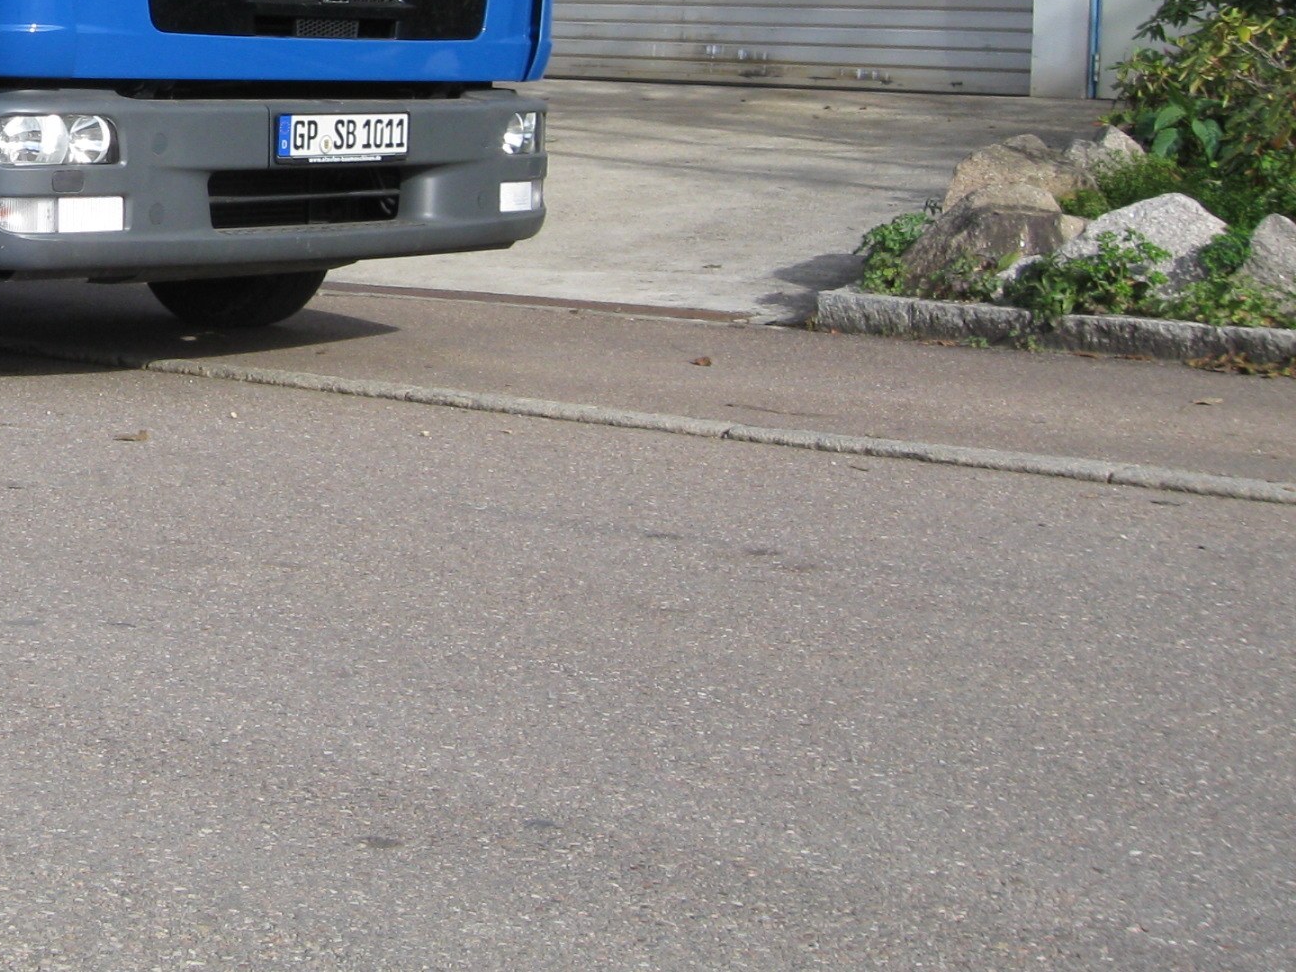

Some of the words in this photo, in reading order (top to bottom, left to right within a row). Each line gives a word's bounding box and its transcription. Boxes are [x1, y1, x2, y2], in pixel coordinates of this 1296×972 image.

[293, 120, 318, 150] GP
[333, 119, 357, 150] SB
[362, 118, 405, 149] 1011
